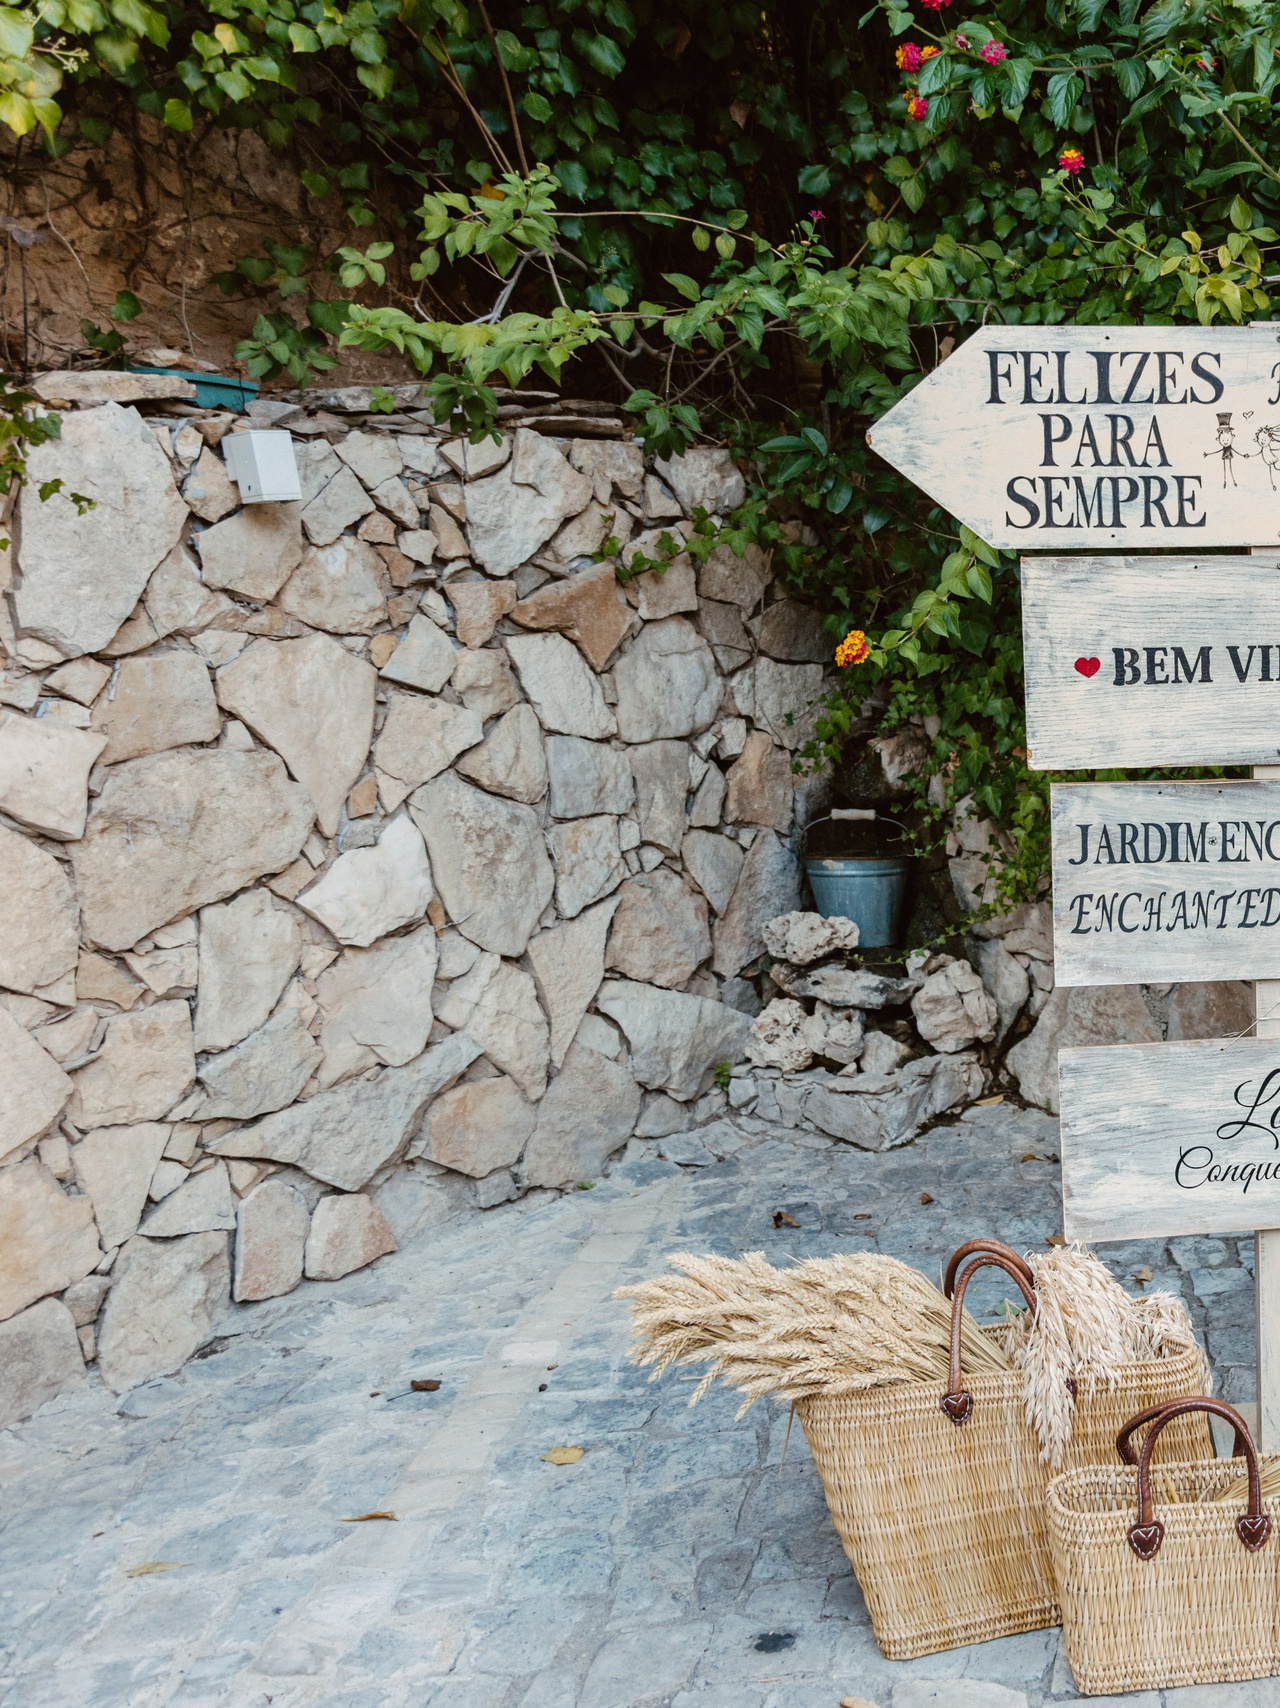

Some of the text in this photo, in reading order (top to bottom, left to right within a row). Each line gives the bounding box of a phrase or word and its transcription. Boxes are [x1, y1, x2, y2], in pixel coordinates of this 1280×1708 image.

[983, 350, 1225, 405] FELIZES
[1038, 413, 1173, 468] PARA
[1005, 475, 1207, 530] SEMPRE
[1112, 646, 1213, 686] BEM
[1068, 821, 1210, 866] JARDIM
